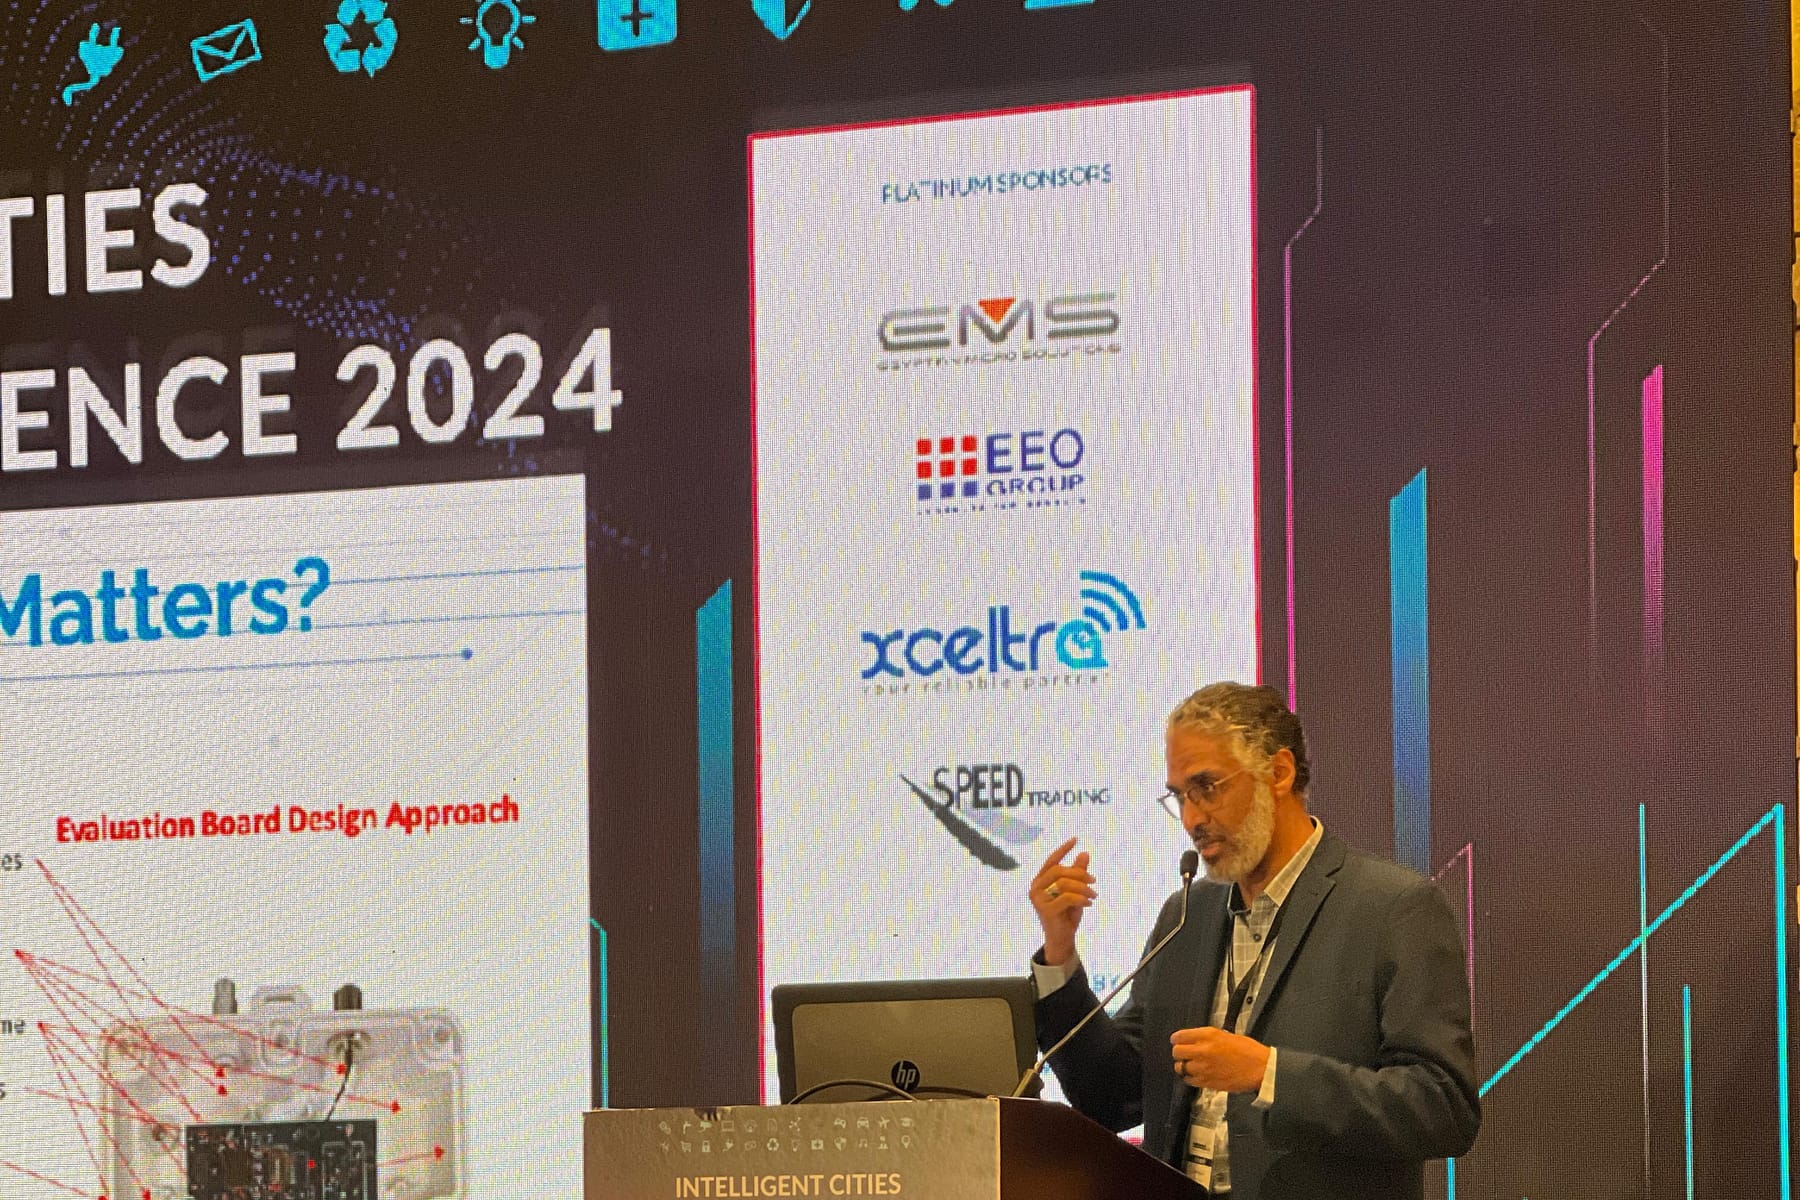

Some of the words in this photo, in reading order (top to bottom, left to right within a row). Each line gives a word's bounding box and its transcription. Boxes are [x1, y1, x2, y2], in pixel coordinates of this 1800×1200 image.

[878, 292, 1121, 351] EMS
[0, 352, 298, 471] ENCE
[336, 328, 623, 450] 2024
[986, 428, 1084, 474] EEO
[986, 473, 1084, 496] GROUP
[0, 556, 331, 648] Matters?
[934, 762, 1024, 808] SPEED
[56, 813, 195, 843] Evaluation
[201, 804, 281, 836] Board
[288, 802, 378, 837] Design
[385, 793, 520, 835] Approach
[896, 1060, 917, 1091] hp
[675, 1174, 824, 1199] INTELLIGENT
[829, 1173, 902, 1196] CITIES
